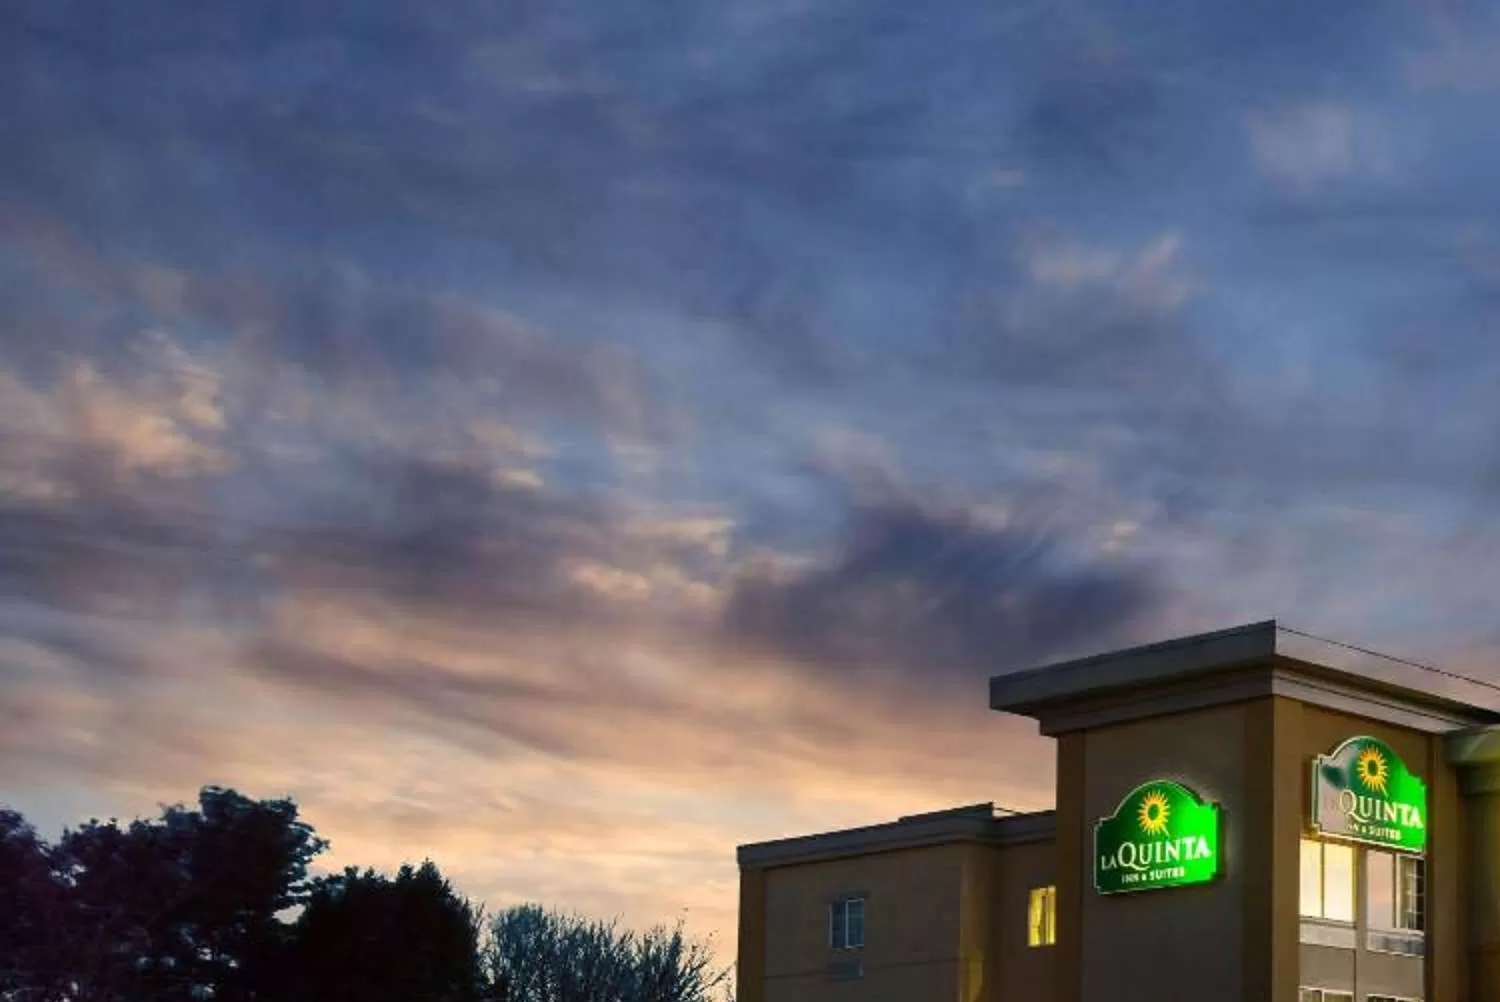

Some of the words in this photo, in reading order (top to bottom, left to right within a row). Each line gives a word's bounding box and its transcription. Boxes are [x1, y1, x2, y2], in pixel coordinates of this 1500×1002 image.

[1340, 789, 1424, 829] QUINTA
[1101, 855, 1117, 870] LA
[1118, 836, 1212, 871] QUINTA
[1149, 866, 1185, 881] SUITES
